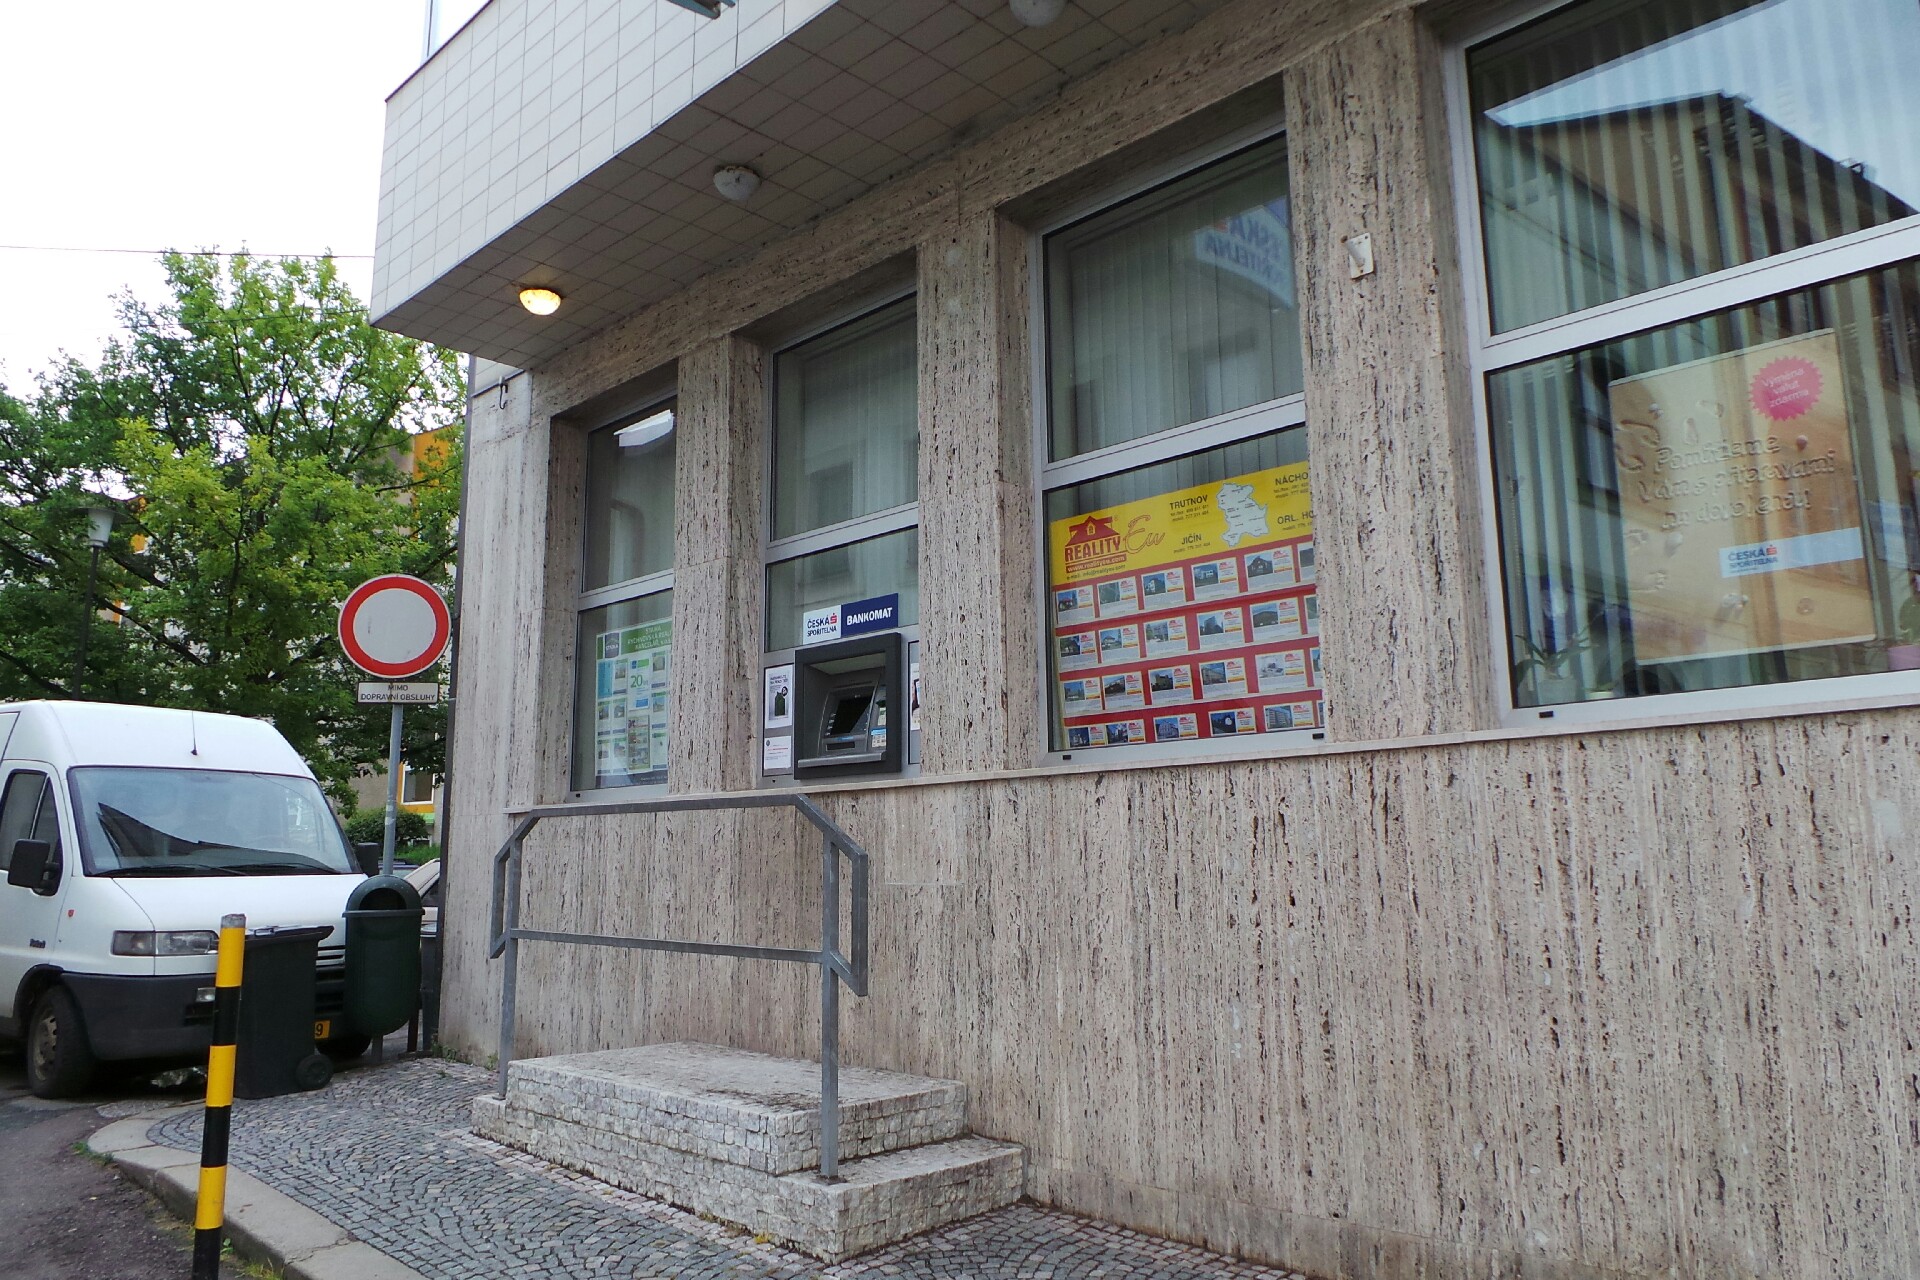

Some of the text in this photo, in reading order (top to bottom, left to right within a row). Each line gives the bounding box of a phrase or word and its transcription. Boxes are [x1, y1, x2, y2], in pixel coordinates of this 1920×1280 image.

[1169, 494, 1208, 510] TRUTNOV
[1181, 532, 1202, 545] JIČÍN
[1064, 536, 1121, 562] REALITY
[807, 614, 829, 629] ČESKÁ
[846, 607, 893, 626] BANKOMAT
[630, 674, 643, 689] 20
[360, 692, 436, 701] DOPRAVNÍ OBSLUHY
